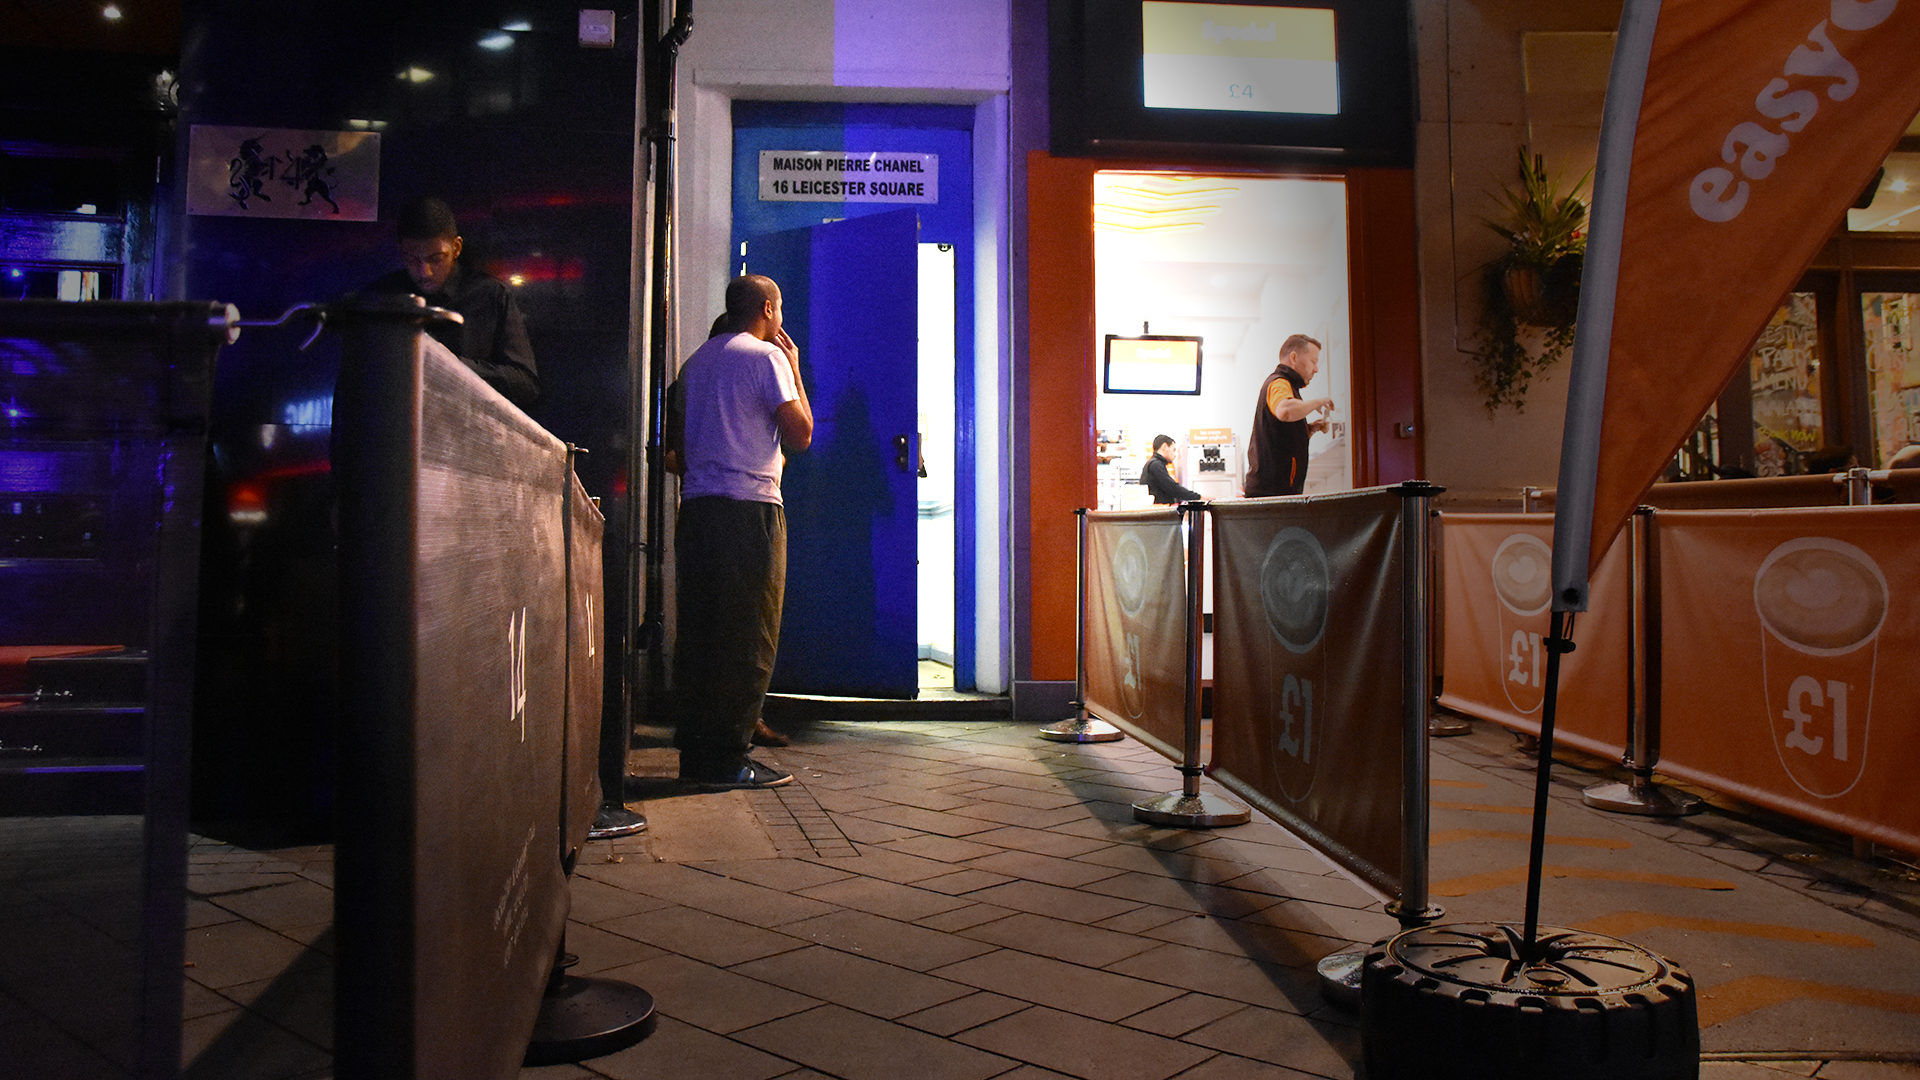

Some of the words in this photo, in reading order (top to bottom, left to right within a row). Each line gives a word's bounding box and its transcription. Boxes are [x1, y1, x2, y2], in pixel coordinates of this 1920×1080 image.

[1229, 83, 1253, 99] £4
[773, 157, 822, 171] MAISON
[826, 158, 871, 172] PIERRE
[874, 159, 924, 173] CHANEL
[772, 180, 789, 194] 16
[792, 180, 866, 195] LEICESTER
[869, 182, 924, 197] SQUARE
[1124, 632, 1142, 692] £1
[1509, 629, 1540, 688] £1
[1278, 673, 1313, 764] £1
